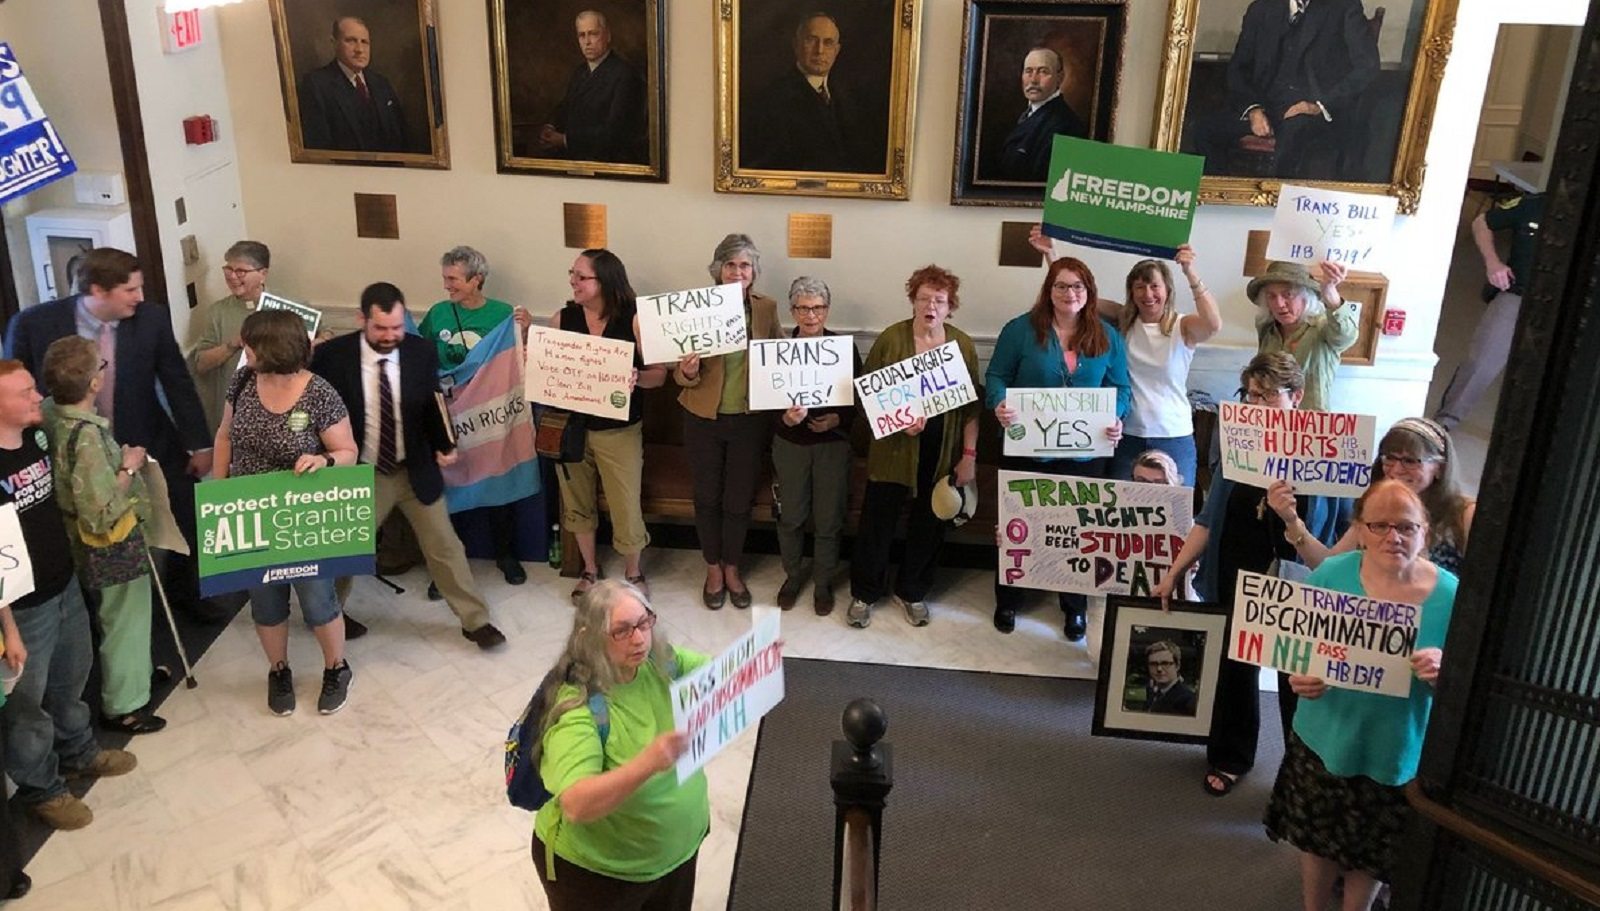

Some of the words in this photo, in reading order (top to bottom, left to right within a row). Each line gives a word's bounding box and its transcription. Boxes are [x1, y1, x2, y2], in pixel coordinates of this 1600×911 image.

[1071, 172, 1192, 208] FREEDOM
[1070, 190, 1103, 207] NEW
[1105, 197, 1189, 220] HAMPSHIRE
[1292, 196, 1340, 216] TRANS
[1347, 204, 1380, 220] BILL
[1290, 244, 1315, 259] HB
[646, 287, 724, 316] TRANS
[661, 315, 724, 337] RIGHTS
[672, 329, 722, 354] YES!
[752, 338, 840, 367] TRANS
[771, 370, 824, 390] BILL
[858, 362, 914, 397] EQUAL
[911, 345, 954, 375] RIGHTS
[786, 385, 833, 406] YES!
[876, 384, 917, 411] FOR
[920, 365, 958, 397] ALL
[478, 396, 526, 428] RIGHTS
[876, 405, 915, 436] PASS
[1222, 403, 1358, 436] DISCRIMINATION
[1033, 417, 1093, 448] YES
[1223, 426, 1250, 438] VOTE
[1253, 429, 1264, 438] TO
[1264, 431, 1339, 459] HURTS
[1340, 436, 1359, 449] HB
[1225, 449, 1259, 473] ALL
[1262, 456, 1289, 480] NH
[1293, 458, 1372, 488] RESIDENTS
[1342, 448, 1368, 461] 1319
[15, 483, 36, 500] FOR
[201, 494, 278, 518] Protect
[284, 486, 371, 506] freedom
[1007, 478, 1118, 508] TRANS
[272, 503, 372, 529] Granite
[1075, 506, 1168, 528] RIGHTS
[202, 529, 216, 555] FOR
[214, 512, 270, 554] ALL
[274, 525, 371, 550] Staters
[1045, 525, 1078, 538] HAVE
[1045, 536, 1080, 551] BEEN
[1080, 531, 1186, 565] STUDIED
[270, 564, 319, 577] FREEDOM
[1066, 557, 1092, 573] TO
[1242, 575, 1293, 601] END
[1300, 587, 1416, 627] TRANSGENDER
[1245, 599, 1418, 659] DISCRIMINATION
[1237, 630, 1264, 664] IN
[1271, 633, 1313, 676] NH
[1316, 641, 1349, 661] PASS
[679, 661, 715, 713] PASS
[718, 692, 747, 745] NH
